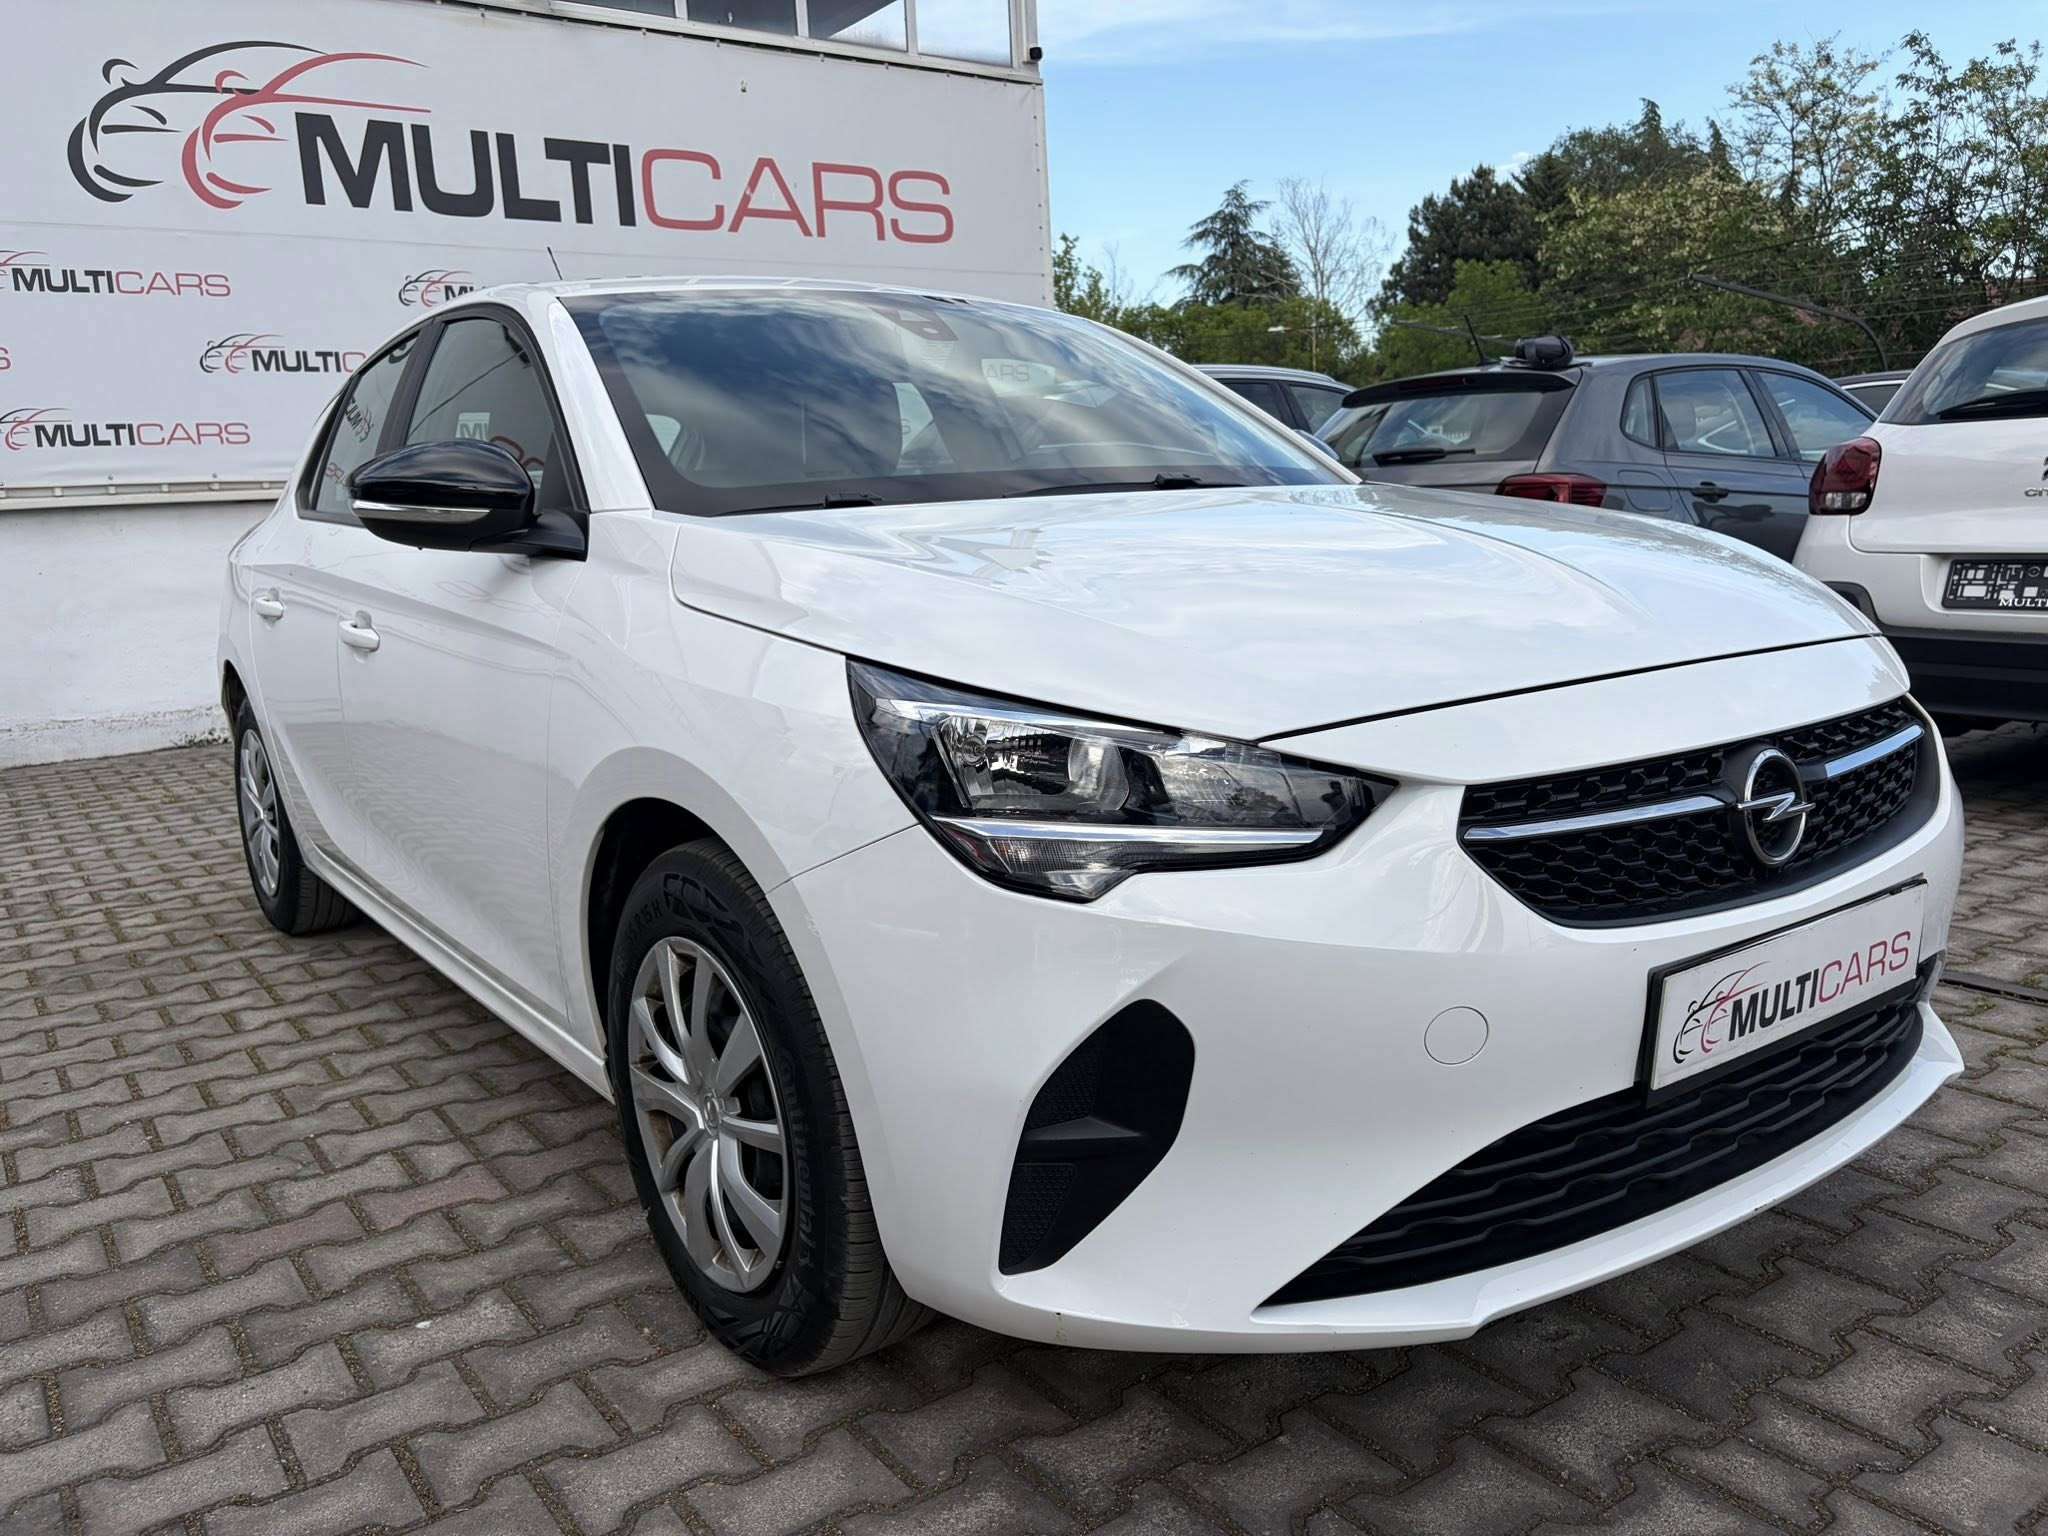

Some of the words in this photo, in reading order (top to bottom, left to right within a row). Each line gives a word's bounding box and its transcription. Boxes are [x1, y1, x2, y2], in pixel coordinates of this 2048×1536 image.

[295, 112, 954, 244] MULTICARS
[11, 267, 231, 297] MULTICARS
[34, 422, 251, 448] MULTICARS
[1728, 931, 1911, 1041] MULTICARS
